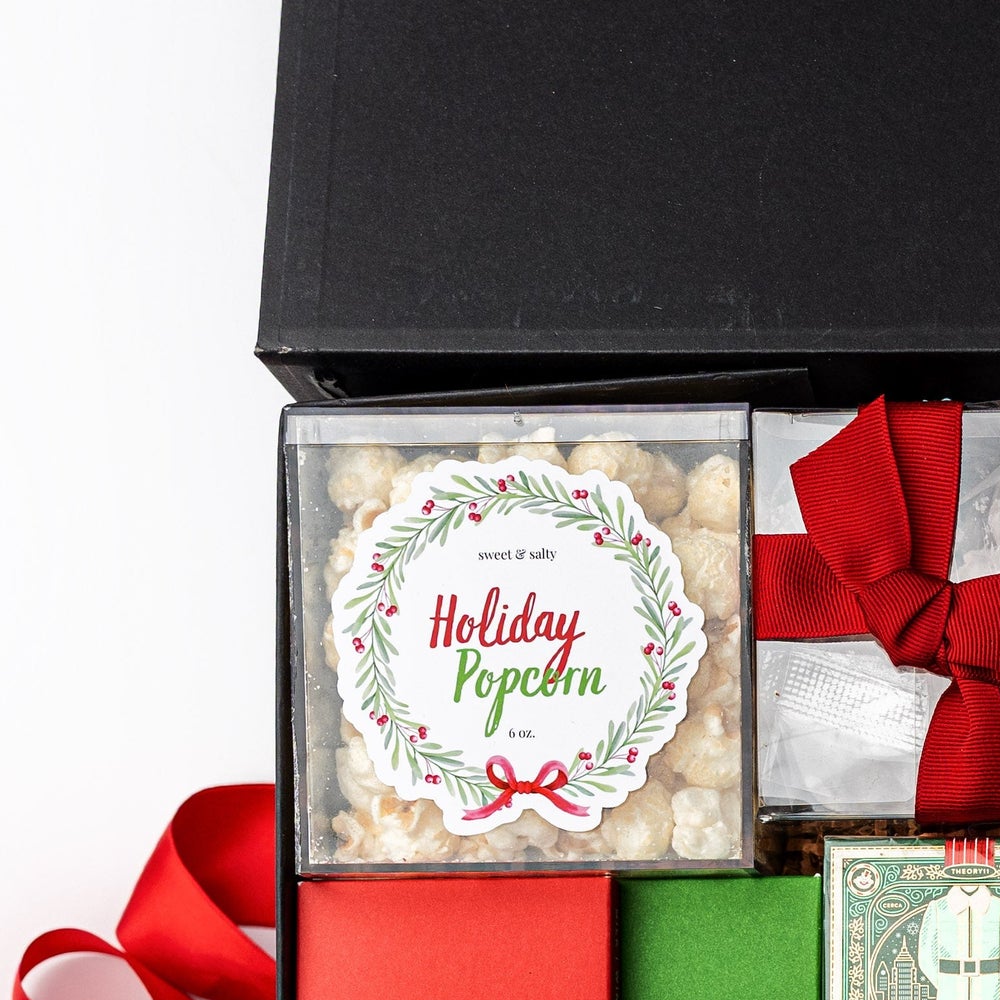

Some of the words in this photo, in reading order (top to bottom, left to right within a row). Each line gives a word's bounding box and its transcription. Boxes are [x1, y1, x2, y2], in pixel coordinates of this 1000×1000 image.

[478, 549, 512, 561] sweet
[515, 548, 526, 561] &
[529, 547, 557, 563] salty
[429, 587, 585, 684] Holiday
[453, 648, 606, 738] Popcorn
[508, 728, 516, 738] 6
[519, 729, 535, 739] oz.
